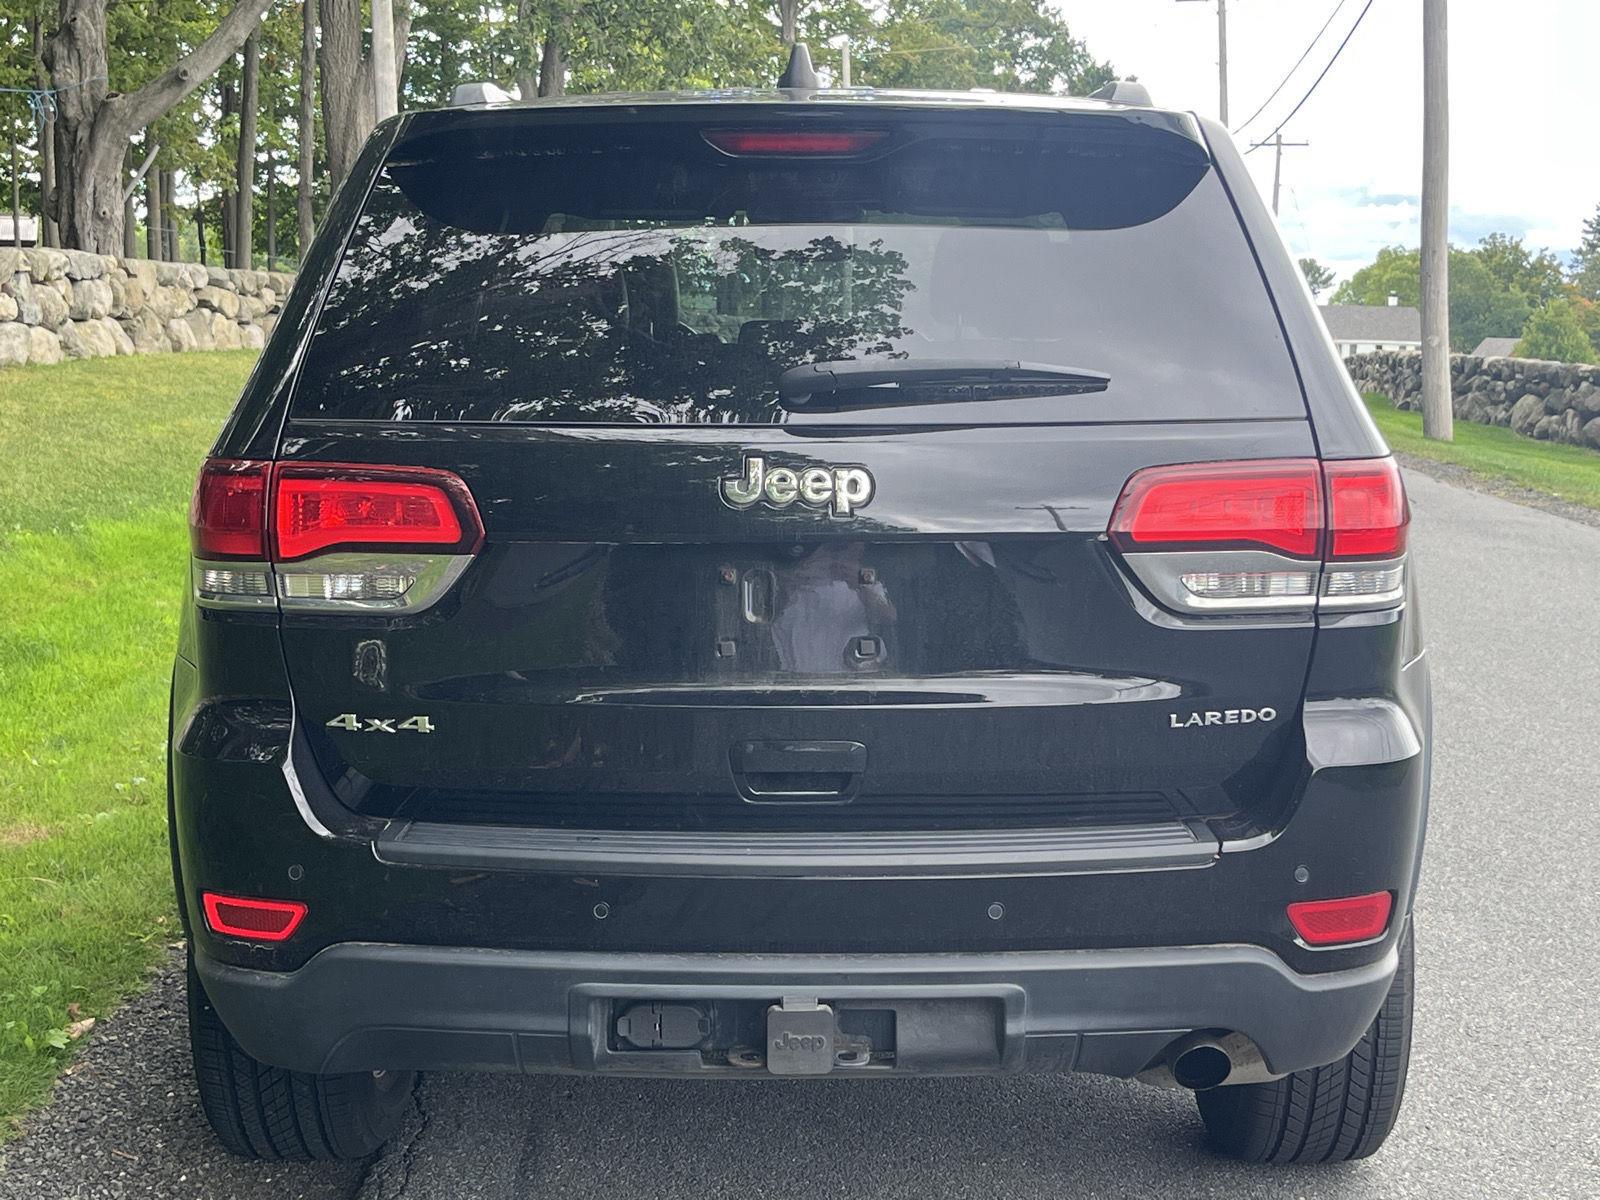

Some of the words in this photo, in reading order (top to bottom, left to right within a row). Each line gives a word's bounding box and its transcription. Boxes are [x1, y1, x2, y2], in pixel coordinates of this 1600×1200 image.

[721, 455, 874, 516] Jeep
[325, 713, 436, 734] 4x4
[1169, 707, 1277, 728] LAREDO
[773, 1031, 826, 1053] Jeep
